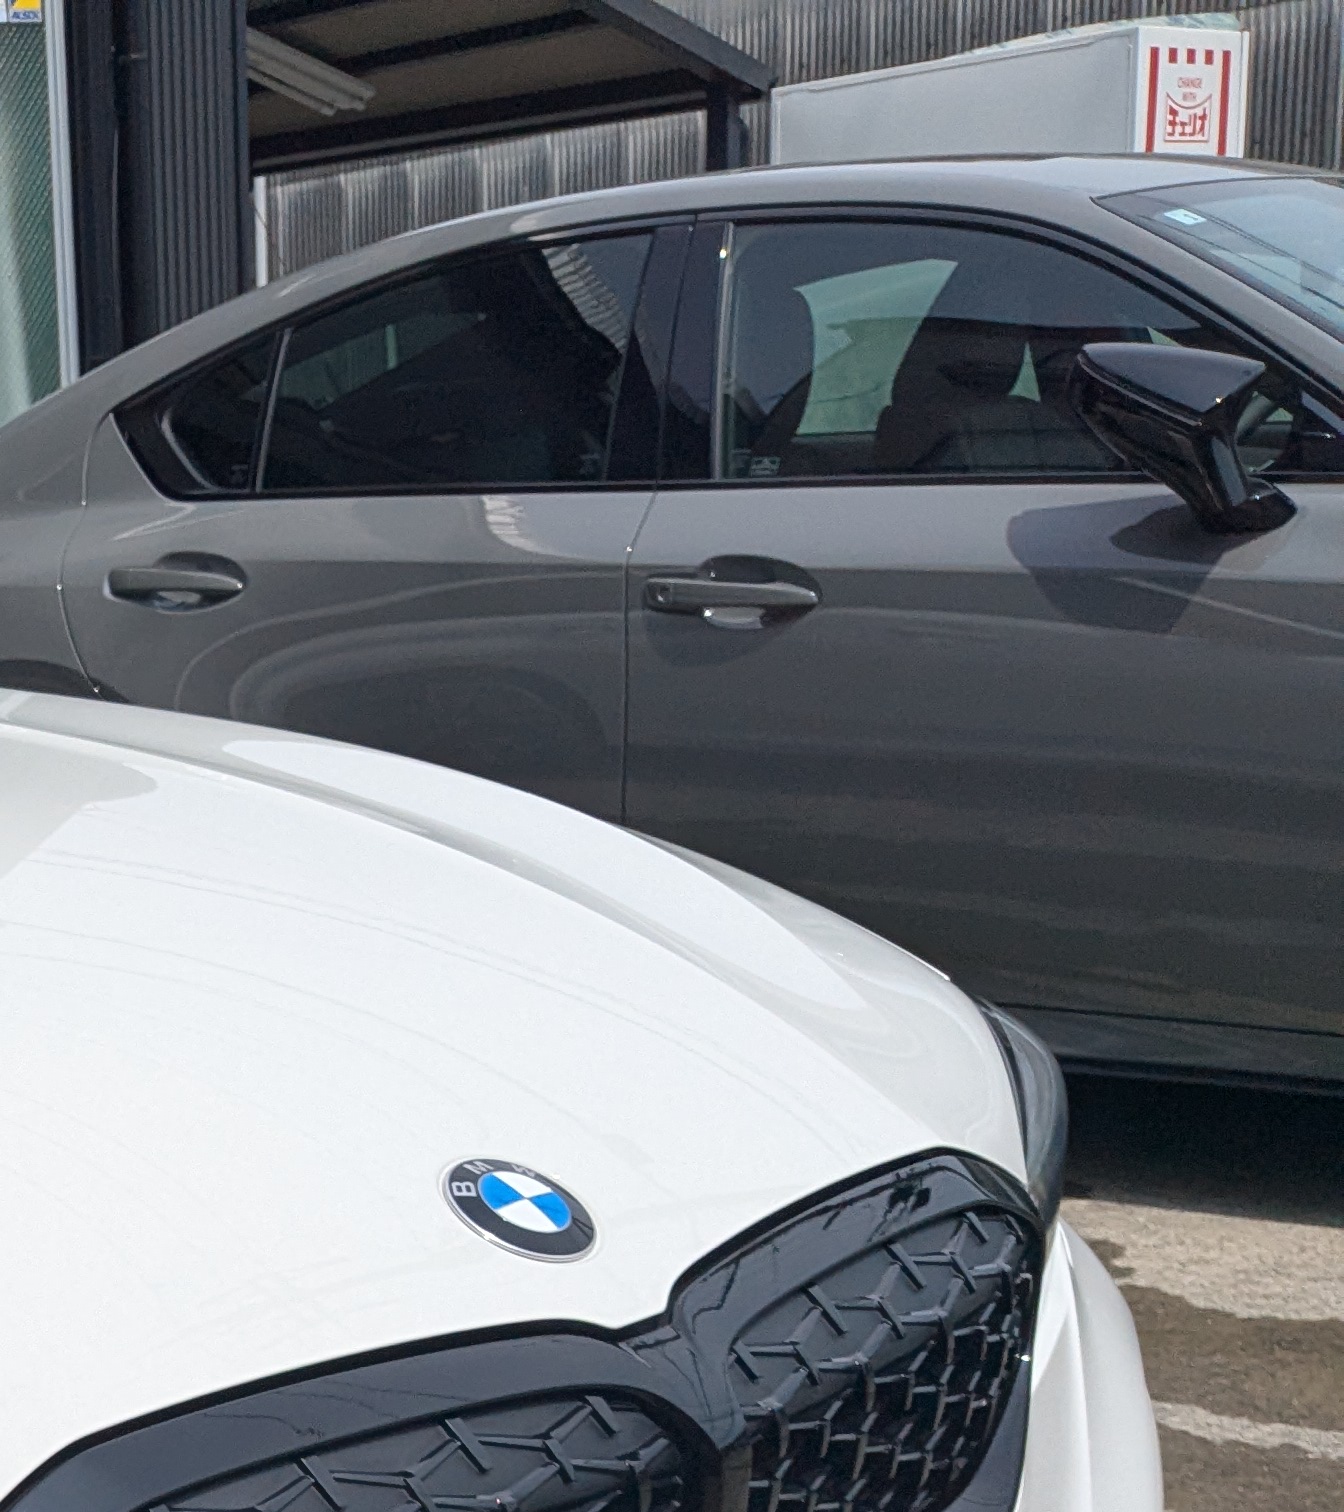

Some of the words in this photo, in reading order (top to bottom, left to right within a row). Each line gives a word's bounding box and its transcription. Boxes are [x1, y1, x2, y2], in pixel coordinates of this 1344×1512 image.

[1167, 105, 1208, 137] チェリオ
[451, 1161, 537, 1198] BMW
